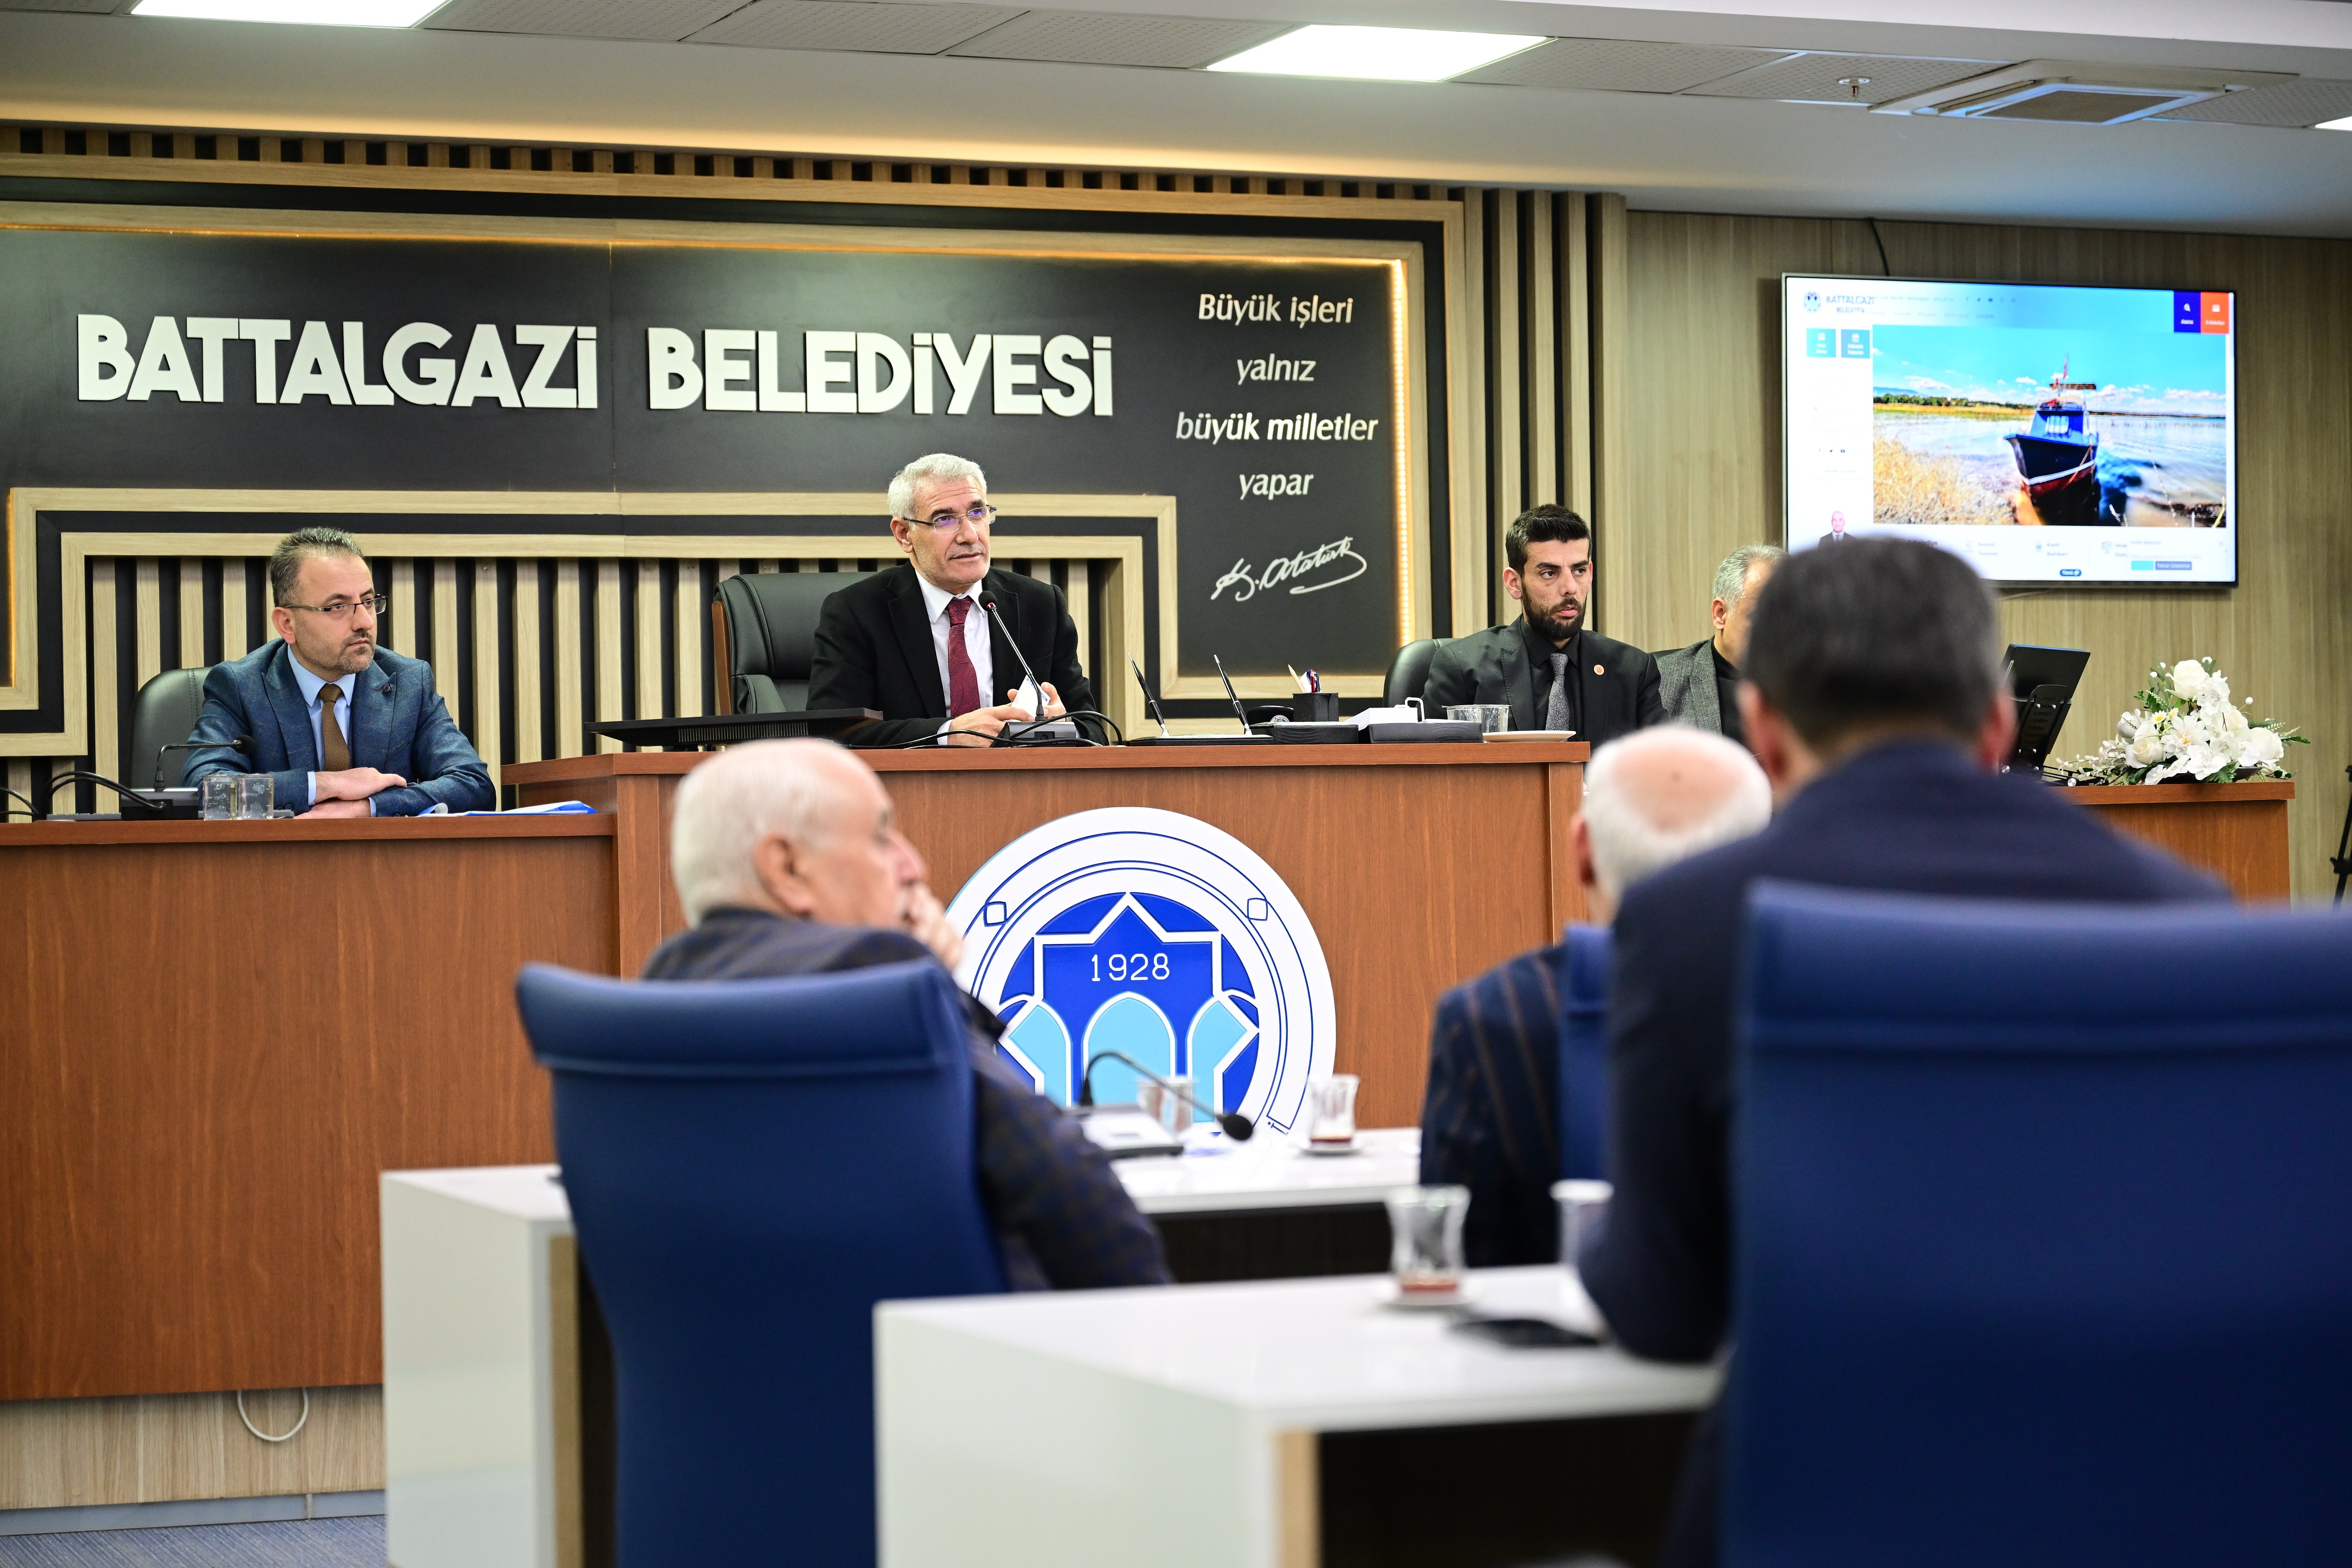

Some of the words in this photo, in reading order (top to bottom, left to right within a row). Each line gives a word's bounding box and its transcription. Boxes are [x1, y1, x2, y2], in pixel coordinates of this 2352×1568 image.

[1198, 293, 1281, 326] Büyük
[1290, 295, 1354, 329] işleri
[1237, 353, 1316, 385] yalnız
[1175, 411, 1260, 445] büyük
[1267, 412, 1379, 441] milletler
[1239, 473, 1314, 500] yapar
[1091, 953, 1170, 982] 1928
